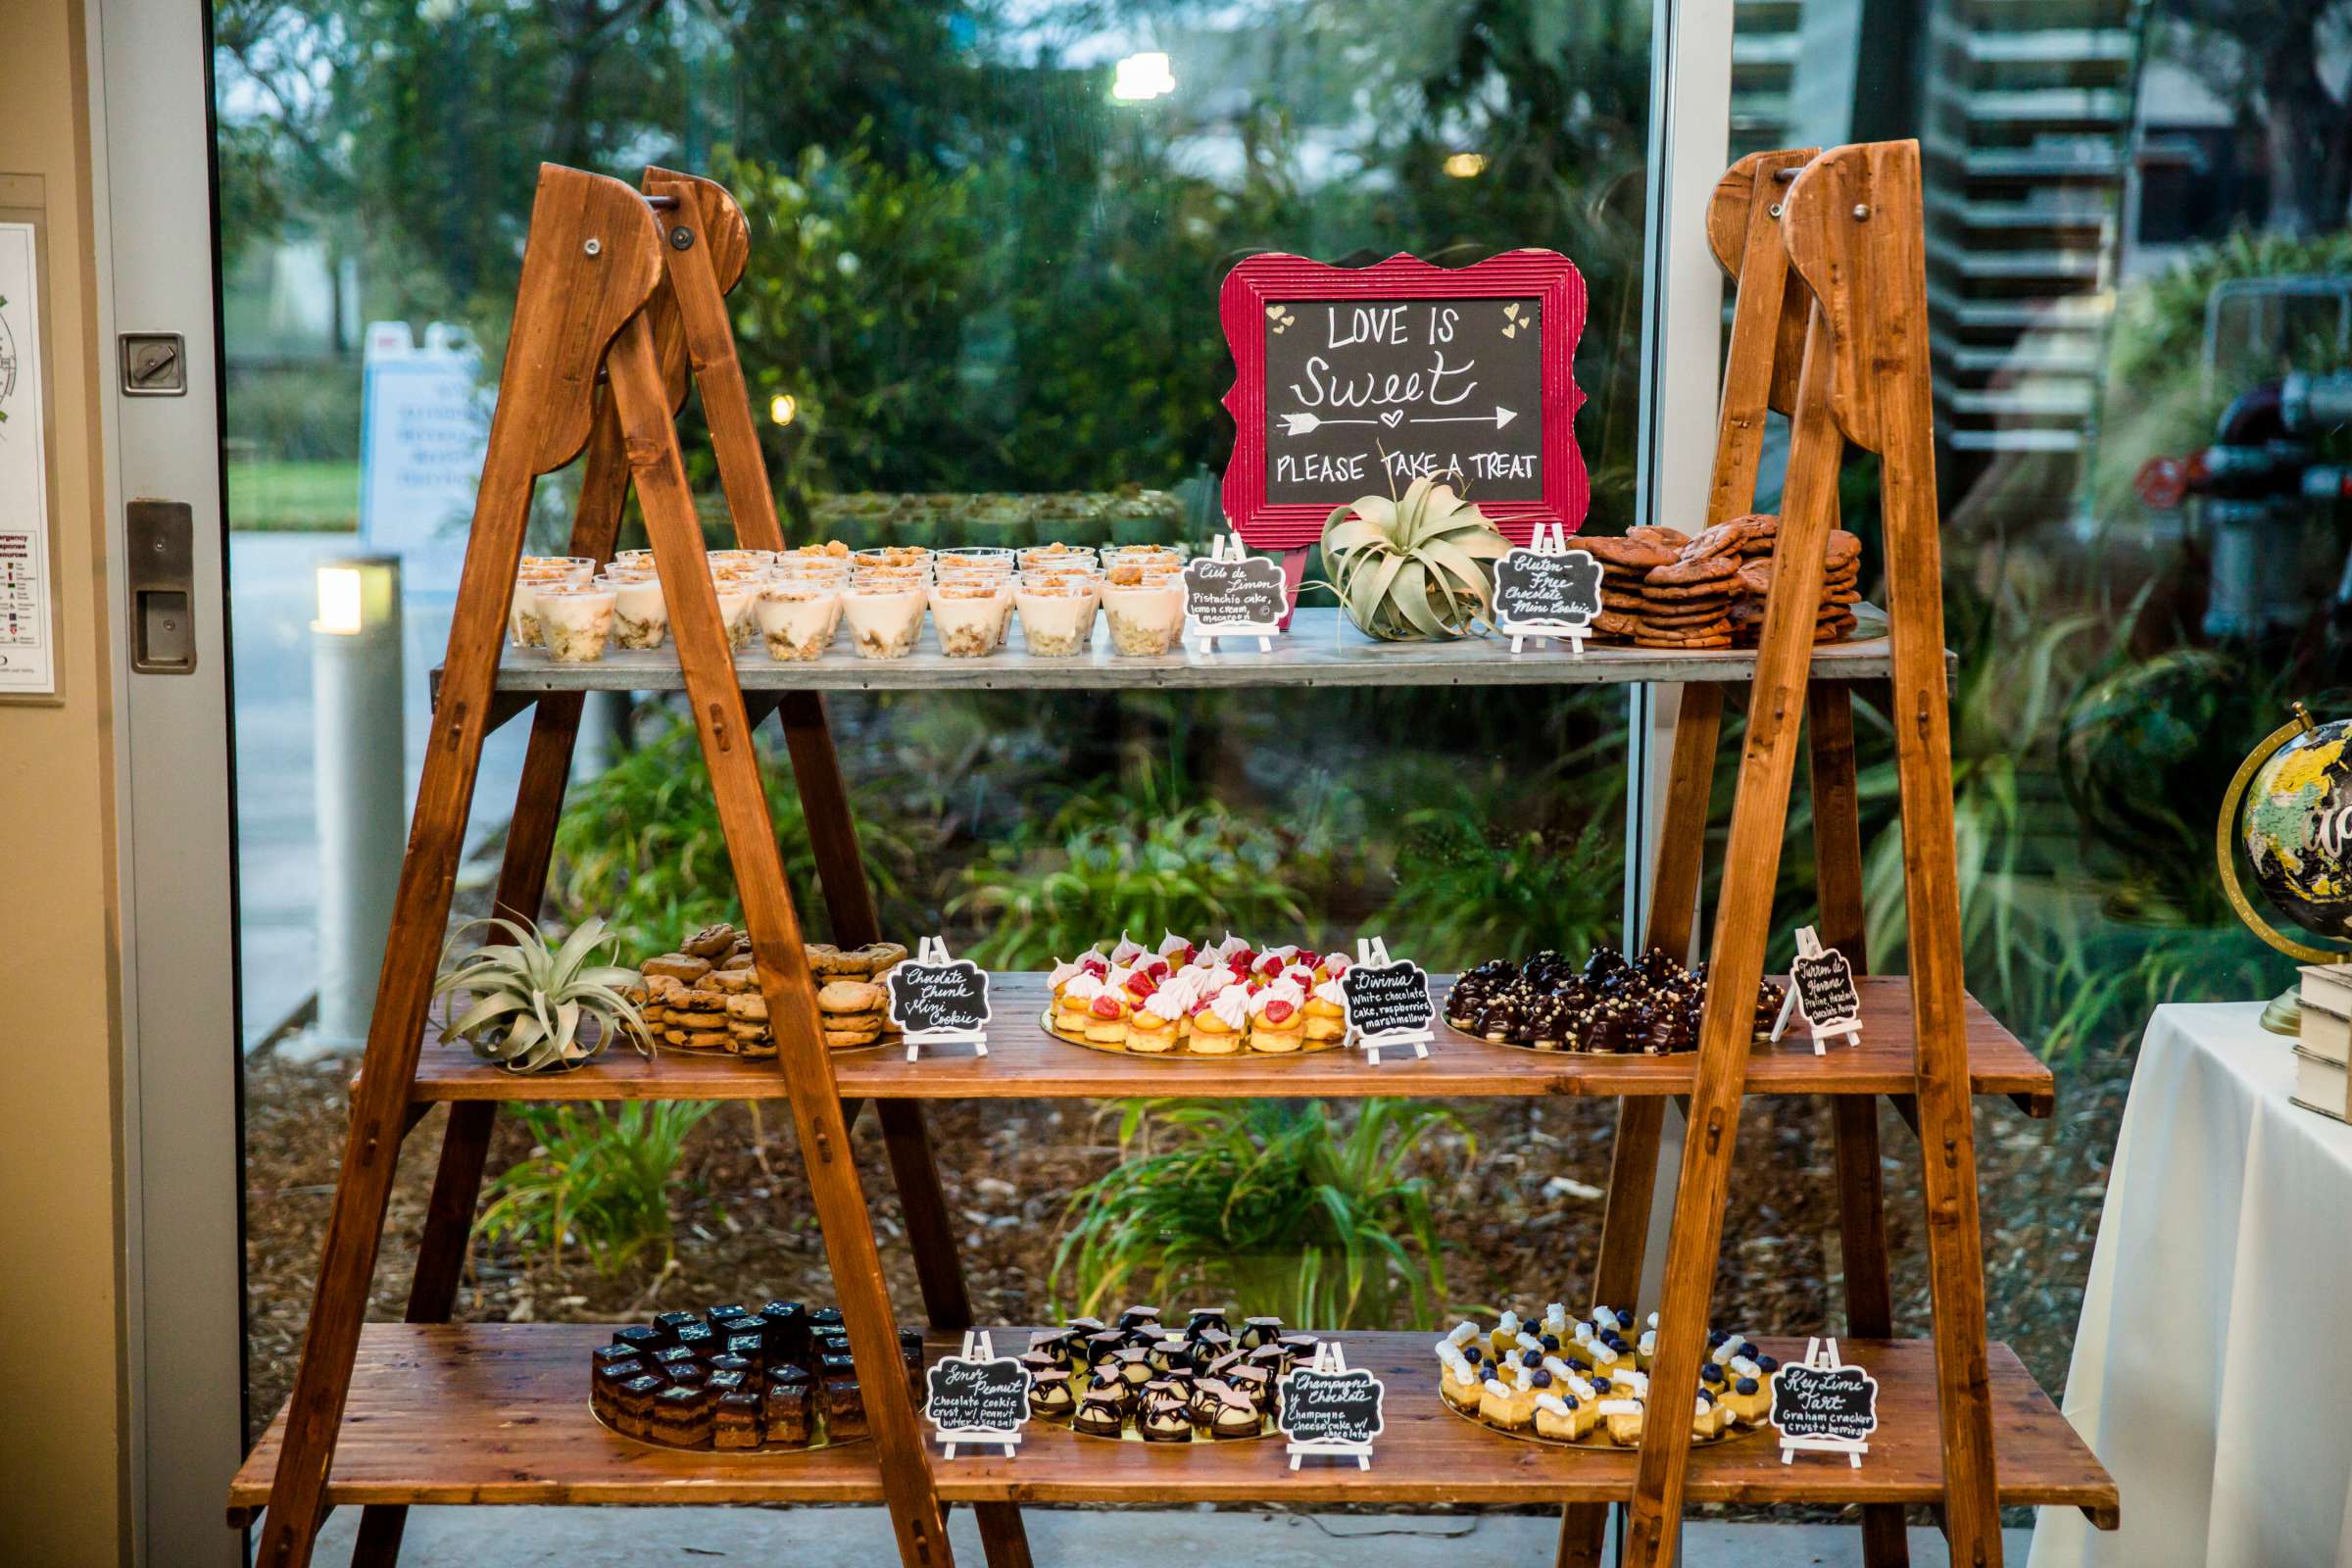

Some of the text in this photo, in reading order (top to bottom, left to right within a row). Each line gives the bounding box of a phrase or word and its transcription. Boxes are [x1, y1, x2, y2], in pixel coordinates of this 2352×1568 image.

[1328, 305, 1459, 349] LOVE IS
[1290, 350, 1478, 407] Sweet
[1277, 450, 1538, 483] PLEASE TAKE A TREAT
[1232, 566, 1247, 578] de
[1530, 572, 1574, 588] Free
[1193, 593, 1240, 604] Pistachio
[1505, 586, 1563, 600] Chocolate
[1191, 605, 1216, 614] lemon
[1512, 600, 1548, 613] Mini
[1833, 958, 1844, 972] de
[906, 968, 967, 985] Chocolate
[921, 984, 974, 999] Chunk
[1351, 988, 1426, 1004] White chocolate
[905, 1000, 946, 1015] Mini
[1353, 1007, 1379, 1019] cake,
[930, 1010, 979, 1026] Cookie
[946, 1365, 988, 1384] Senor
[1785, 1370, 1864, 1393] Key Lime
[968, 1380, 1022, 1396] Peanut
[1296, 1375, 1370, 1394] Champagne
[934, 1396, 1017, 1407] Chocolate cookie
[1290, 1390, 1372, 1411] y Chocolate
[1797, 1391, 1846, 1409] Tart
[943, 1414, 972, 1427] butter
[965, 1408, 977, 1419] w/
[980, 1407, 1015, 1419] peanut
[1288, 1410, 1346, 1423] Champagne
[1783, 1409, 1872, 1424] Graham cracker
[1354, 1417, 1368, 1428] w/
[1788, 1422, 1818, 1431] crust
[1829, 1423, 1862, 1436] berries
[1323, 1430, 1369, 1439] chocolate
